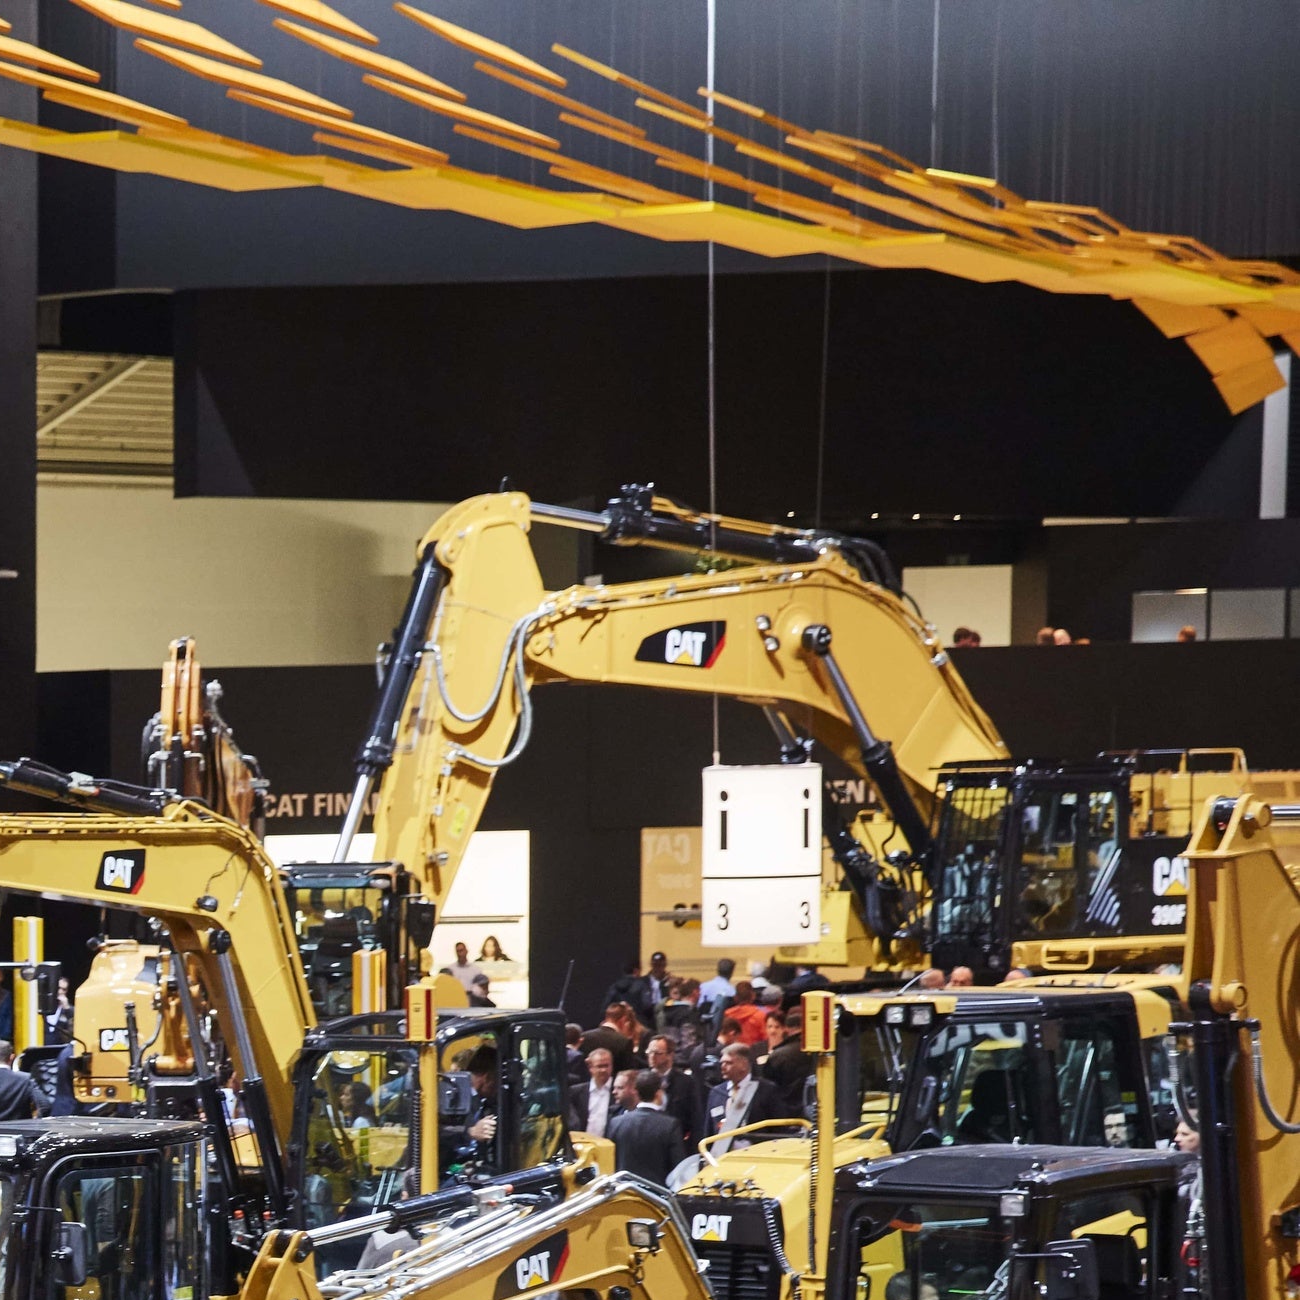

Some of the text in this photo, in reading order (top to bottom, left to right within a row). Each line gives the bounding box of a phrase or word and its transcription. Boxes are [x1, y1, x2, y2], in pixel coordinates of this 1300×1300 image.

[665, 629, 707, 667] CAT
[265, 794, 308, 817] CAT
[103, 856, 136, 889] CAT
[718, 901, 811, 931] 3 3
[691, 1214, 732, 1242] CAT
[515, 1251, 550, 1290] CAT
